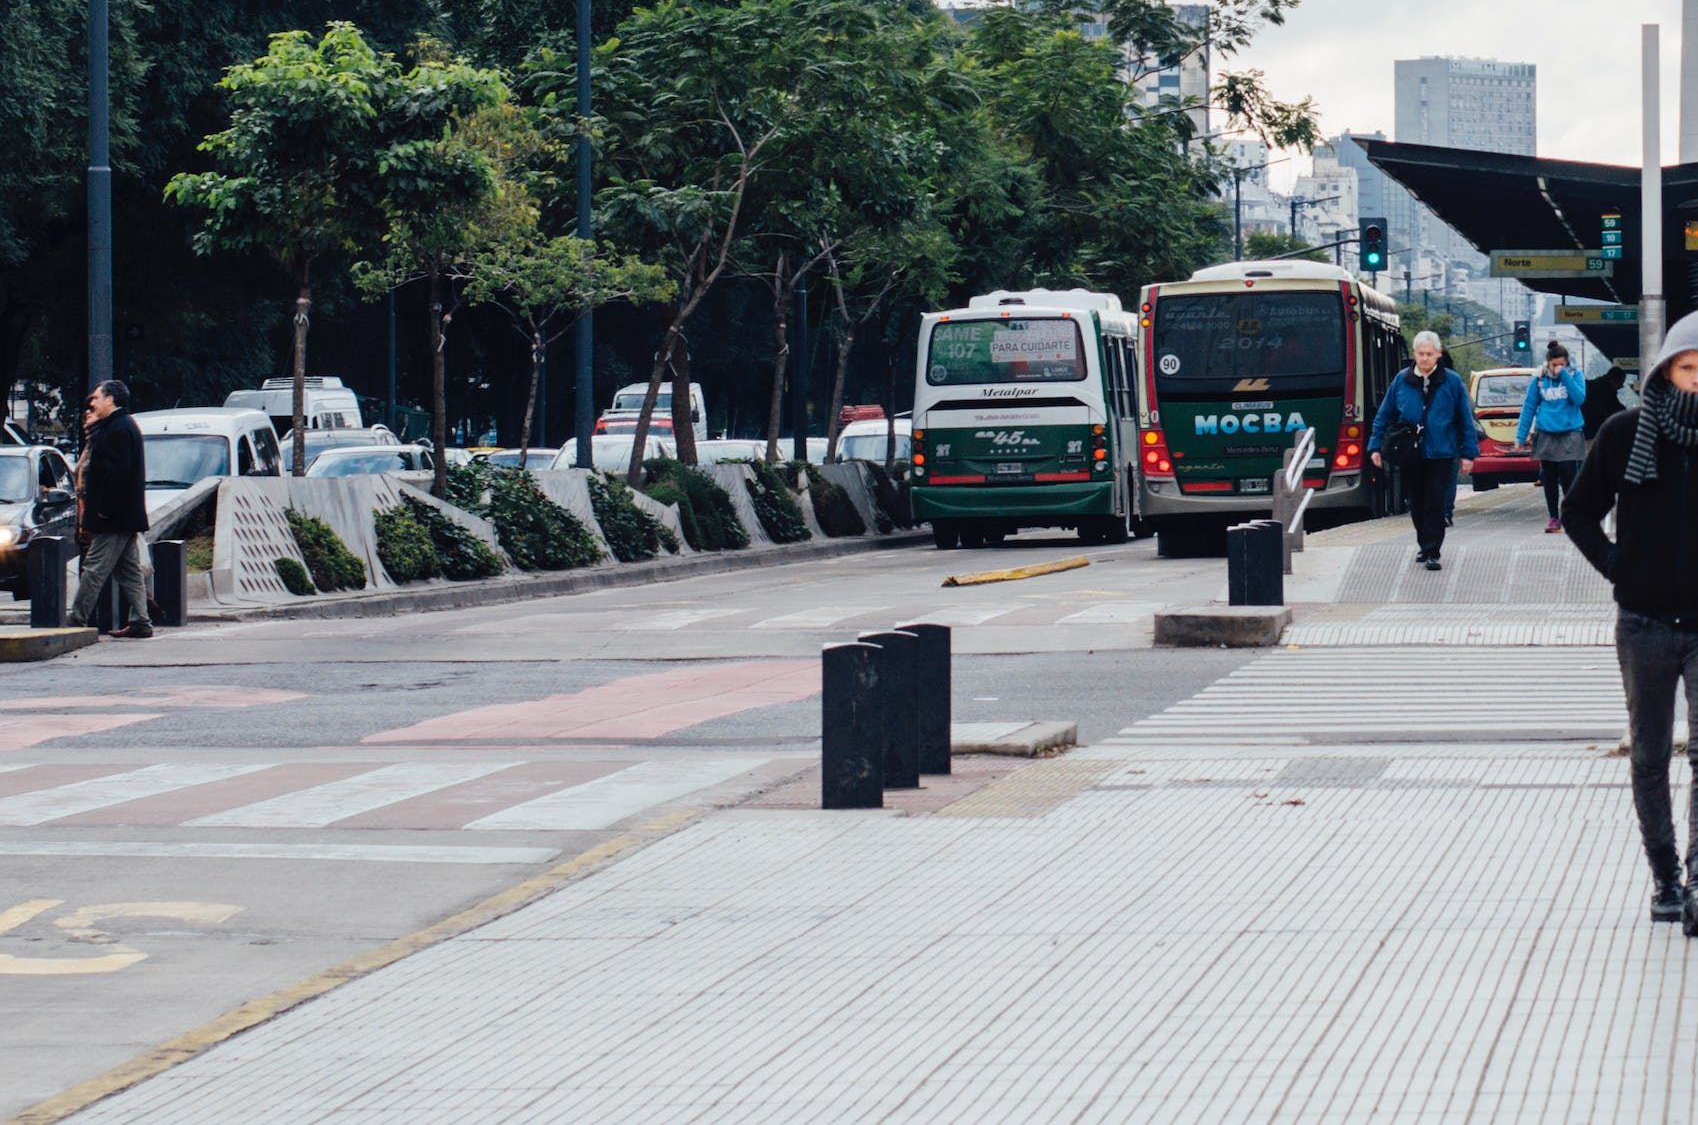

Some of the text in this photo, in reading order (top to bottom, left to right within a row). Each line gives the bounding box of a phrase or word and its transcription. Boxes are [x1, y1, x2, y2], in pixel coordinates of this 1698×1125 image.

[1604, 219, 1616, 227] 59
[1606, 234, 1615, 242] 10
[1606, 249, 1616, 257] 17
[1504, 258, 1531, 267] Norte
[1588, 258, 1603, 269] 59
[934, 327, 982, 341] SAME
[992, 340, 1071, 352] PARA CUIDARTE
[1218, 336, 1283, 349] 2014
[948, 343, 976, 359] 107
[1163, 359, 1177, 370] 90
[980, 387, 1039, 398] Metalpar
[1195, 412, 1307, 435] MOCBA
[993, 431, 1024, 445] 45
